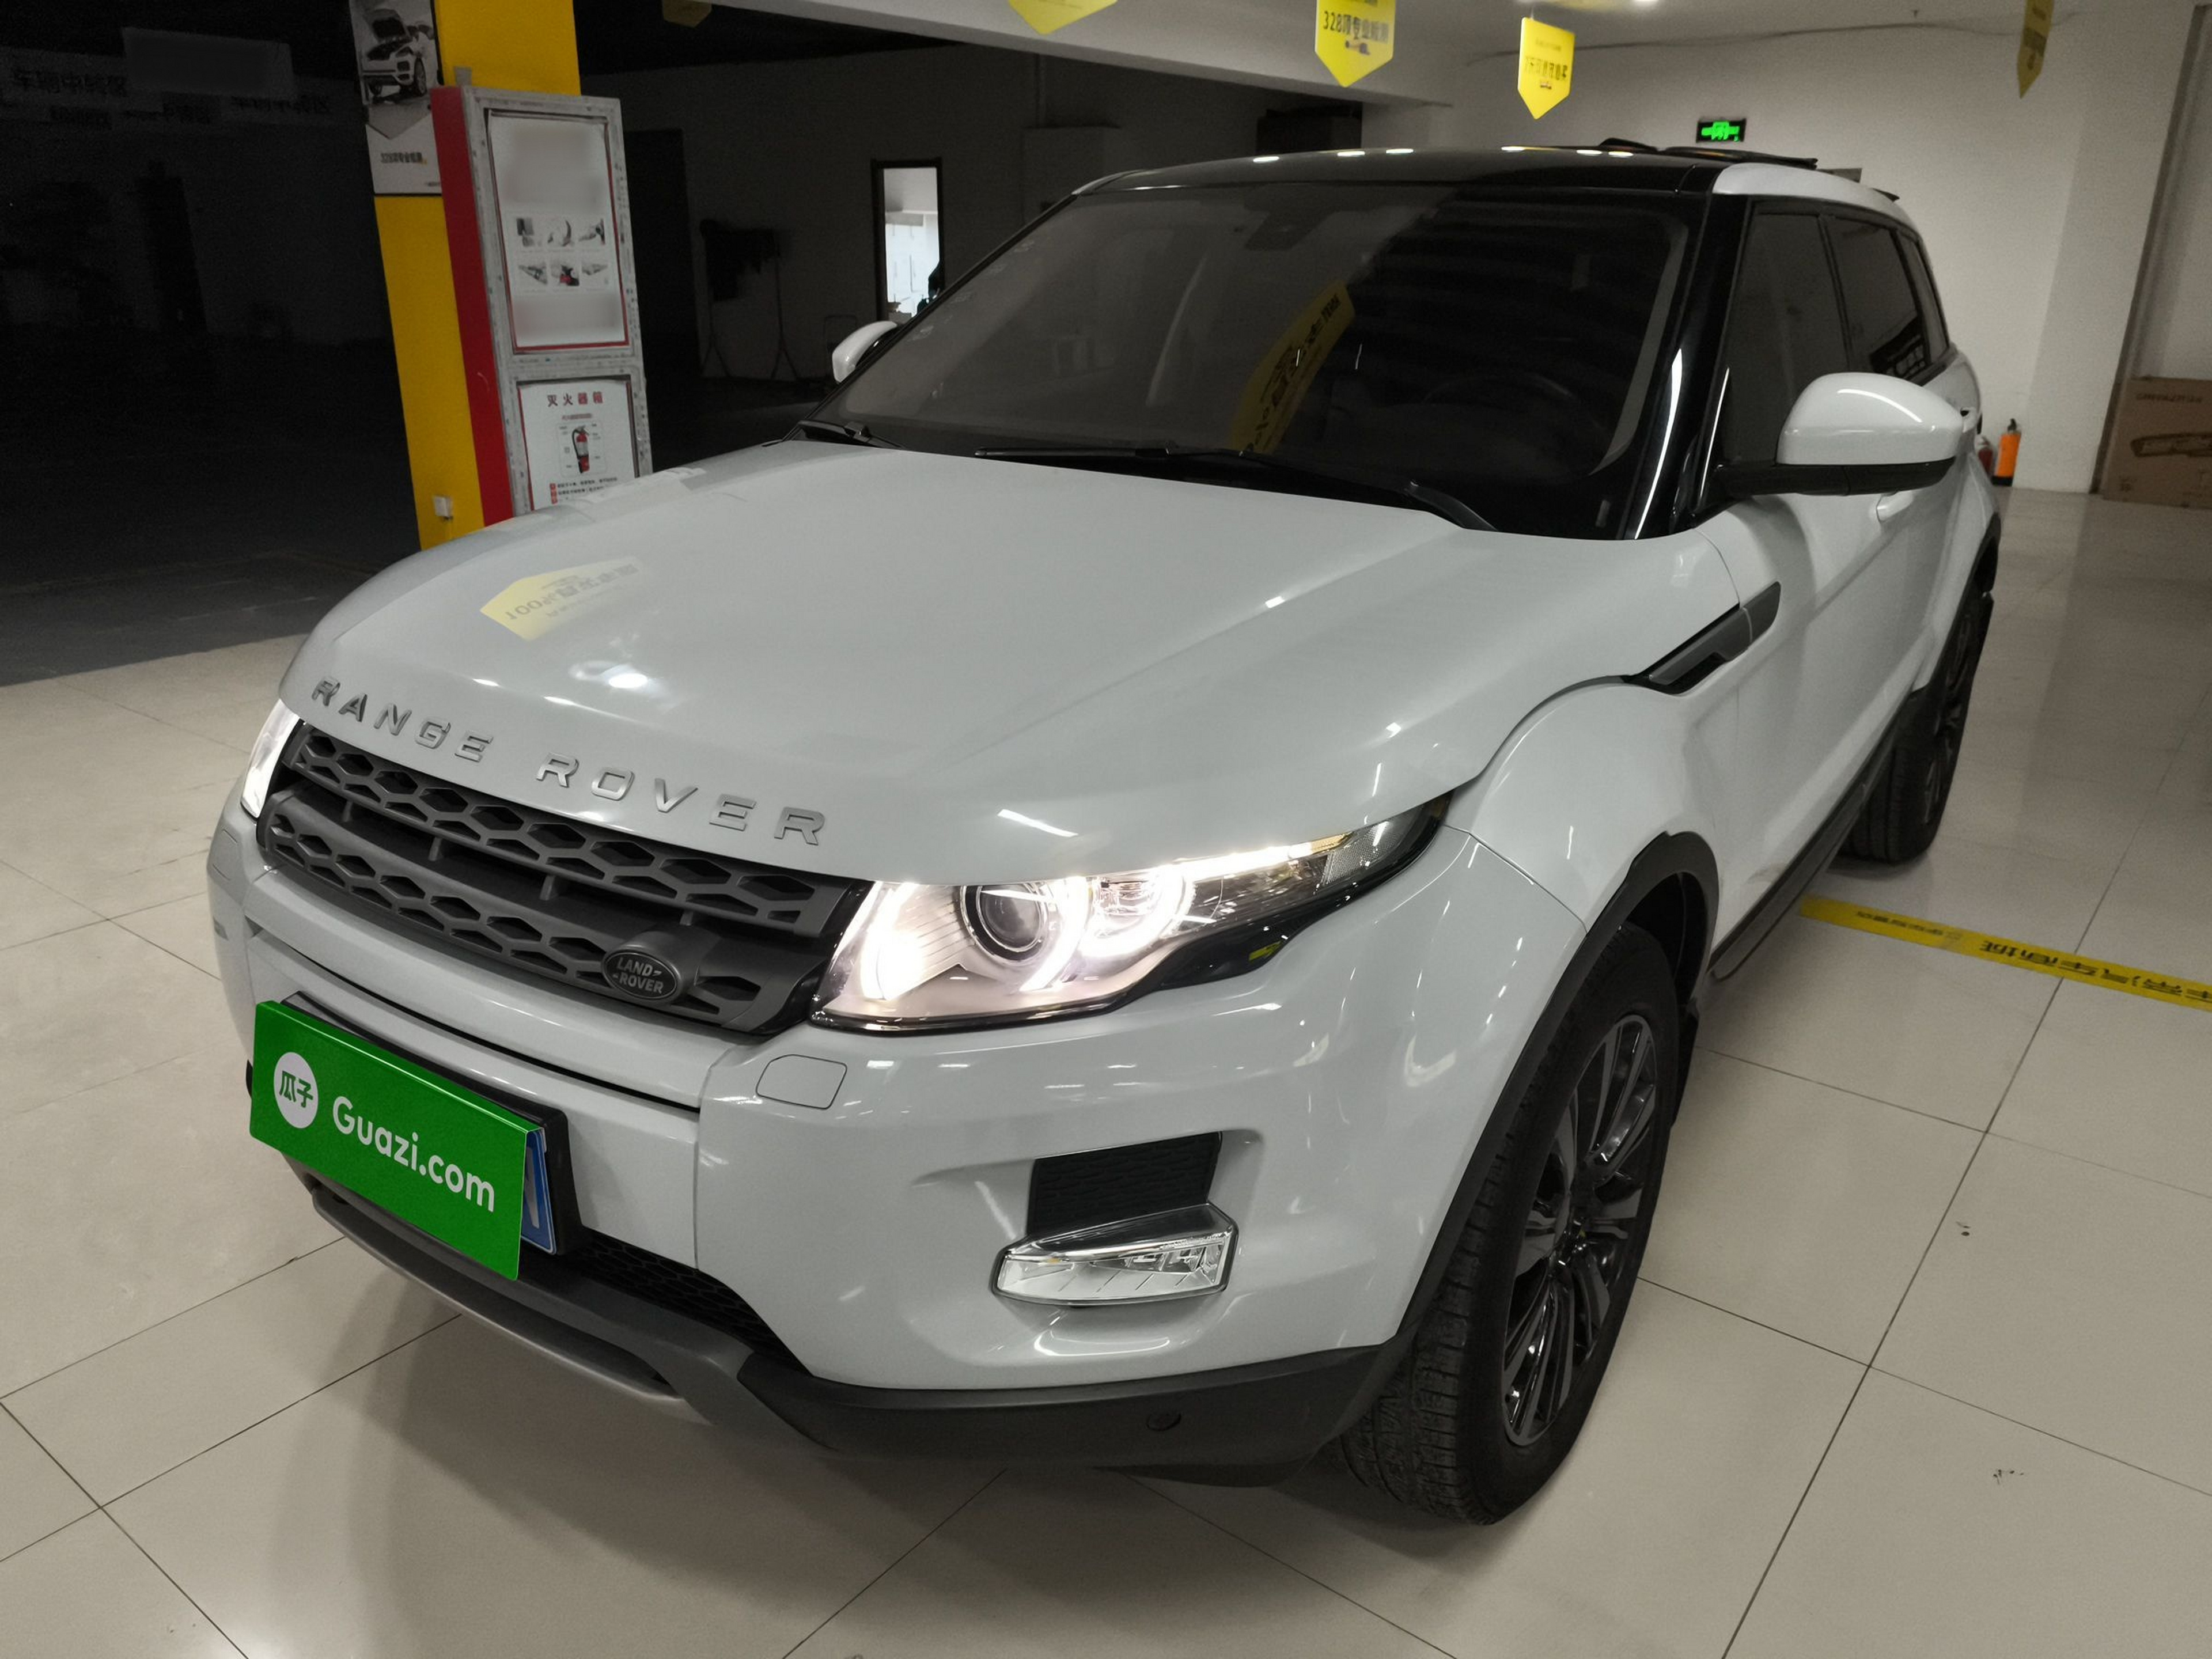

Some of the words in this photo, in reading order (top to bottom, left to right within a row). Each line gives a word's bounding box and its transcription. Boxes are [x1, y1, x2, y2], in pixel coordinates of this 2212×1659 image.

[547, 391, 603, 408] 灭火器箱
[312, 676, 494, 763] RANGE
[536, 751, 825, 845] ROVER
[617, 957, 653, 976] LAND
[619, 972, 664, 994] ROVER
[279, 1070, 314, 1108] 瓜子
[332, 1096, 495, 1213] Guazi.com
